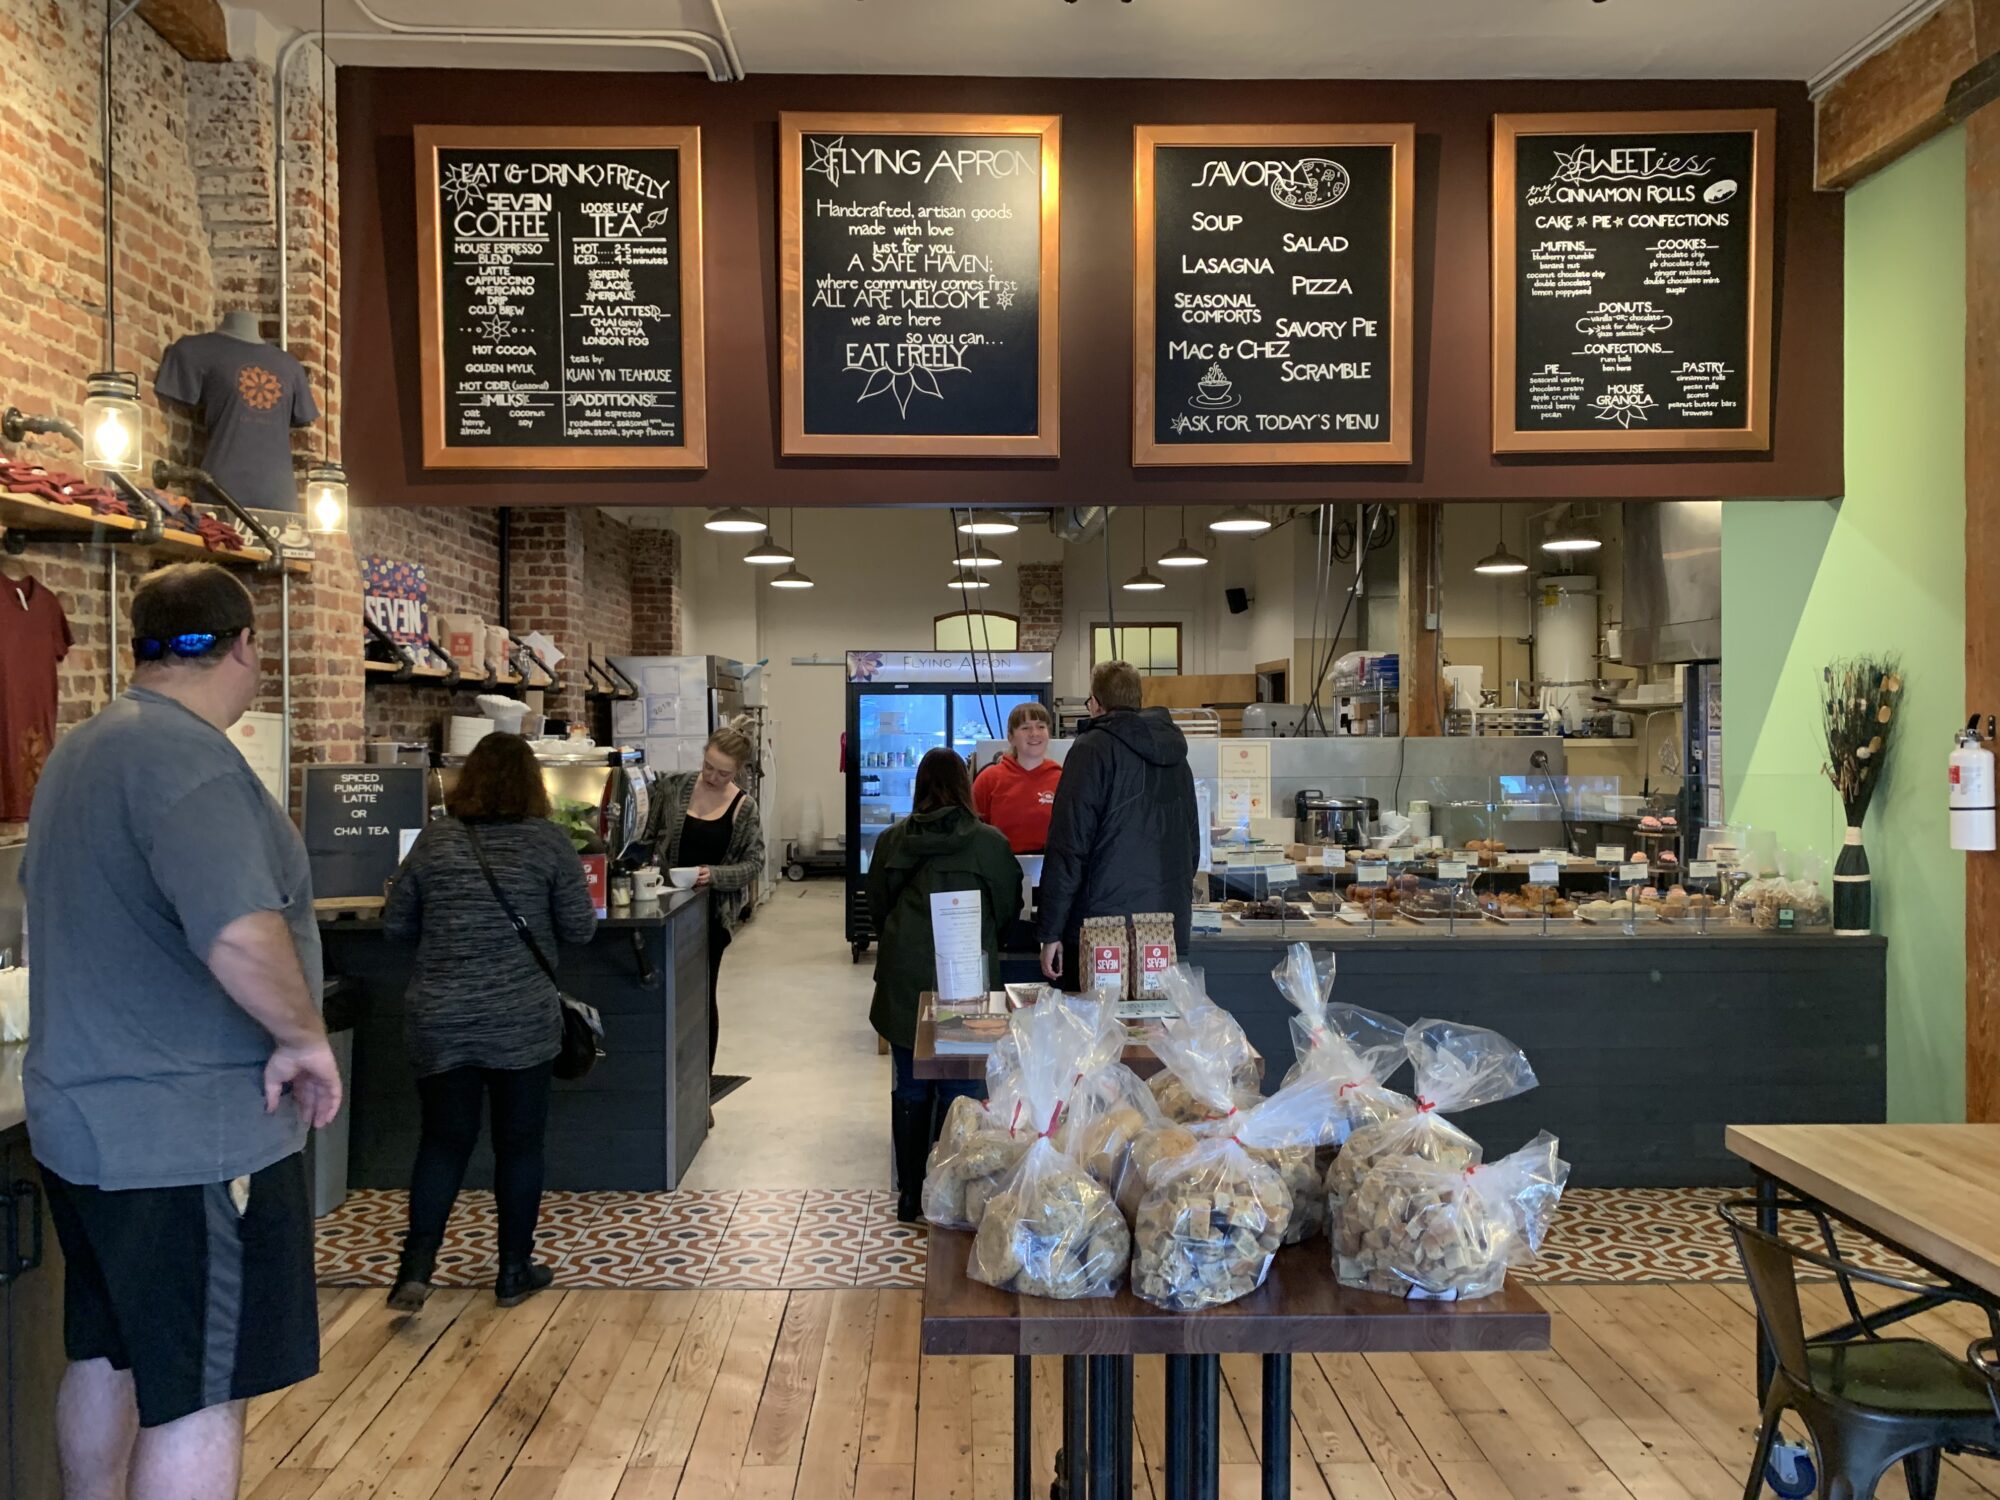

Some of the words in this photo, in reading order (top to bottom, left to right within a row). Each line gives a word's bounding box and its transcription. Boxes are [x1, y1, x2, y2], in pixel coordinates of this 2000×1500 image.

[829, 148, 920, 183] FLYING
[924, 150, 1037, 183] APRON
[1192, 161, 1303, 191] SAVORY
[462, 164, 500, 183] EAT
[607, 164, 670, 199] FREELY
[1526, 182, 1557, 199] try
[1528, 196, 1556, 206] our
[1556, 185, 1641, 203] CINNAMON
[1647, 185, 1695, 204] ROLLS
[487, 193, 551, 212] SEVEN
[581, 203, 614, 213] LOOSE
[617, 203, 643, 213] LEAF
[817, 199, 914, 218] Handcrafted,
[918, 205, 965, 218] artisan
[971, 203, 1012, 221] goods
[454, 212, 549, 236] COFFEE
[590, 213, 641, 236] TEA
[1536, 215, 1573, 231] CAKE
[1593, 215, 1611, 228] PIE
[1628, 214, 1729, 228] CONFECTIONS
[849, 220, 886, 235] made
[894, 221, 921, 236] with
[928, 221, 954, 235] love
[455, 244, 490, 254] HOUSE
[494, 244, 542, 255] ESPRESSO
[872, 241, 898, 256] just
[902, 238, 922, 253] for
[929, 242, 955, 257] you.
[1541, 241, 1585, 251] MUFFINS
[1658, 239, 1707, 250] COOKIES
[478, 255, 512, 264] BLEND
[1656, 251, 1688, 259] chocolate
[1691, 251, 1705, 259] chip
[847, 254, 864, 272] A
[871, 253, 916, 272] SAFE
[925, 254, 993, 272] HAVEN:
[1696, 260, 1710, 268] chip
[479, 267, 510, 275] LATTE
[595, 270, 623, 279] GREEN
[1592, 270, 1605, 279] chip
[466, 276, 535, 285] CAPPUCCINO
[596, 281, 625, 289] BLACK
[817, 274, 858, 289] where
[864, 277, 937, 292] community
[941, 279, 984, 289] comes
[988, 274, 1018, 291] first
[1558, 279, 1591, 287] chocolate
[475, 286, 534, 296] AMERICANO
[488, 296, 507, 305] DRIP
[593, 292, 630, 301] HERBAL
[812, 290, 845, 308] ALL
[854, 290, 892, 310] ARE
[902, 290, 990, 309] WELCOME
[469, 306, 496, 315] COLD
[500, 306, 524, 315] BREW
[581, 305, 604, 315] TEA
[607, 305, 651, 316] LATTES
[1599, 302, 1652, 313] DONUTS
[852, 316, 870, 325] we
[877, 315, 902, 325] are
[908, 309, 941, 326] here
[1182, 309, 1261, 324] COMFORTS
[591, 318, 617, 326] CHAI
[595, 328, 645, 336] MATCHA
[583, 337, 625, 345] LONDON
[628, 337, 649, 346] FOG
[906, 333, 922, 344] so
[928, 334, 954, 346] you
[473, 346, 492, 354] HOT
[496, 346, 536, 355] COCOA
[1218, 345, 1233, 359] &
[1584, 343, 1661, 354] CONFECTIONS
[570, 355, 589, 364] teas
[847, 343, 889, 367] EAT
[897, 344, 968, 367] FREELY
[466, 364, 503, 373] GOLDEN
[507, 364, 536, 375] MYLK
[1545, 365, 1559, 374] PIE
[1682, 362, 1724, 373] PASTRY
[567, 370, 595, 382] KUAN
[600, 369, 616, 381] YIN
[619, 369, 672, 382] TEAHOUSE
[1530, 376, 1558, 384] seasonal
[1560, 376, 1584, 384] variety
[459, 382, 481, 390] HOT
[485, 381, 511, 390] CIDER
[1607, 385, 1644, 394] HOUSE
[487, 394, 523, 406] MILKS
[573, 395, 650, 406] ADDITIONS
[1596, 394, 1653, 405] GRANOLA
[1668, 401, 1693, 409] peanut
[605, 410, 641, 419] espresso
[1682, 409, 1713, 417] brownies
[462, 419, 485, 427] hemp
[1180, 416, 1214, 433] ASK
[1216, 415, 1251, 432] FOR
[1256, 414, 1330, 430] TODAY'S
[1336, 414, 1379, 430] MENU
[460, 427, 490, 435] almond
[903, 656, 952, 671] FLYING
[959, 656, 1011, 671] APRON
[341, 774, 379, 782] SPICED
[334, 784, 383, 792] PUMPKIN
[343, 795, 377, 803] LATTE
[351, 810, 367, 818] OR
[334, 827, 361, 836] CHAI
[368, 827, 389, 835] TEA
